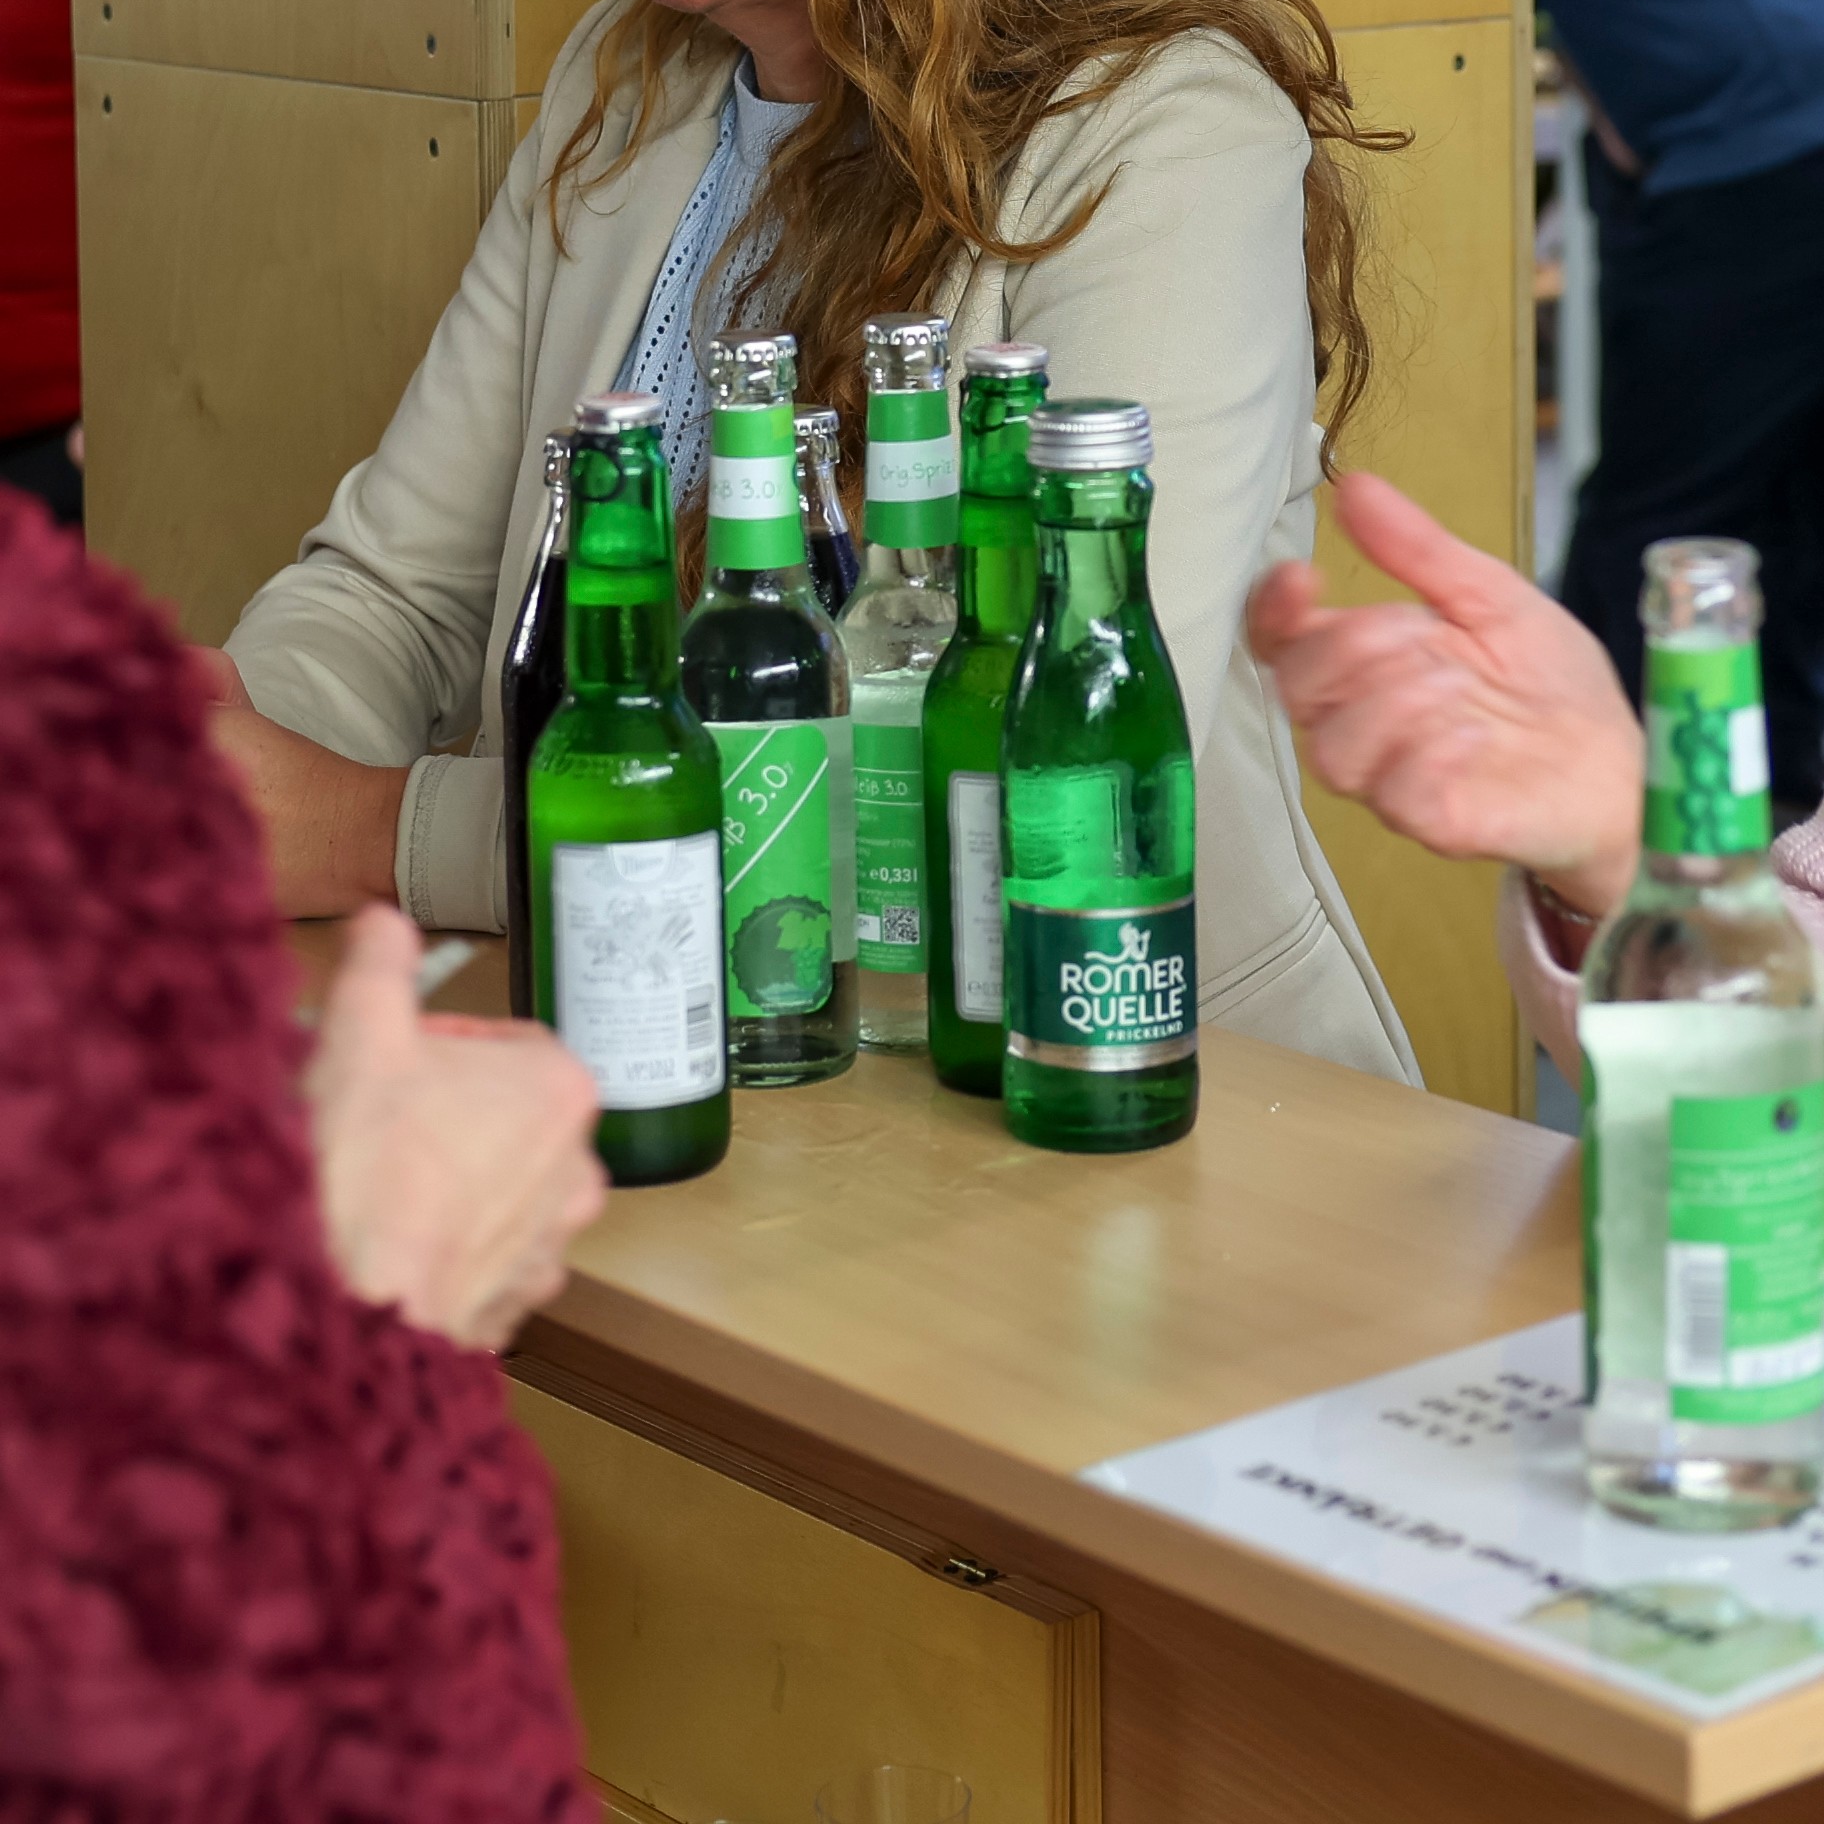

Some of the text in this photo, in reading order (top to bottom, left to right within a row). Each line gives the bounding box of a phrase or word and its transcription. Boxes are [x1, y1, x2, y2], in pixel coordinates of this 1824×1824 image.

[738, 765, 788, 816] 3.0
[1061, 988, 1184, 1034] QUELLE
[1106, 1020, 1184, 1042] PRICKELND
